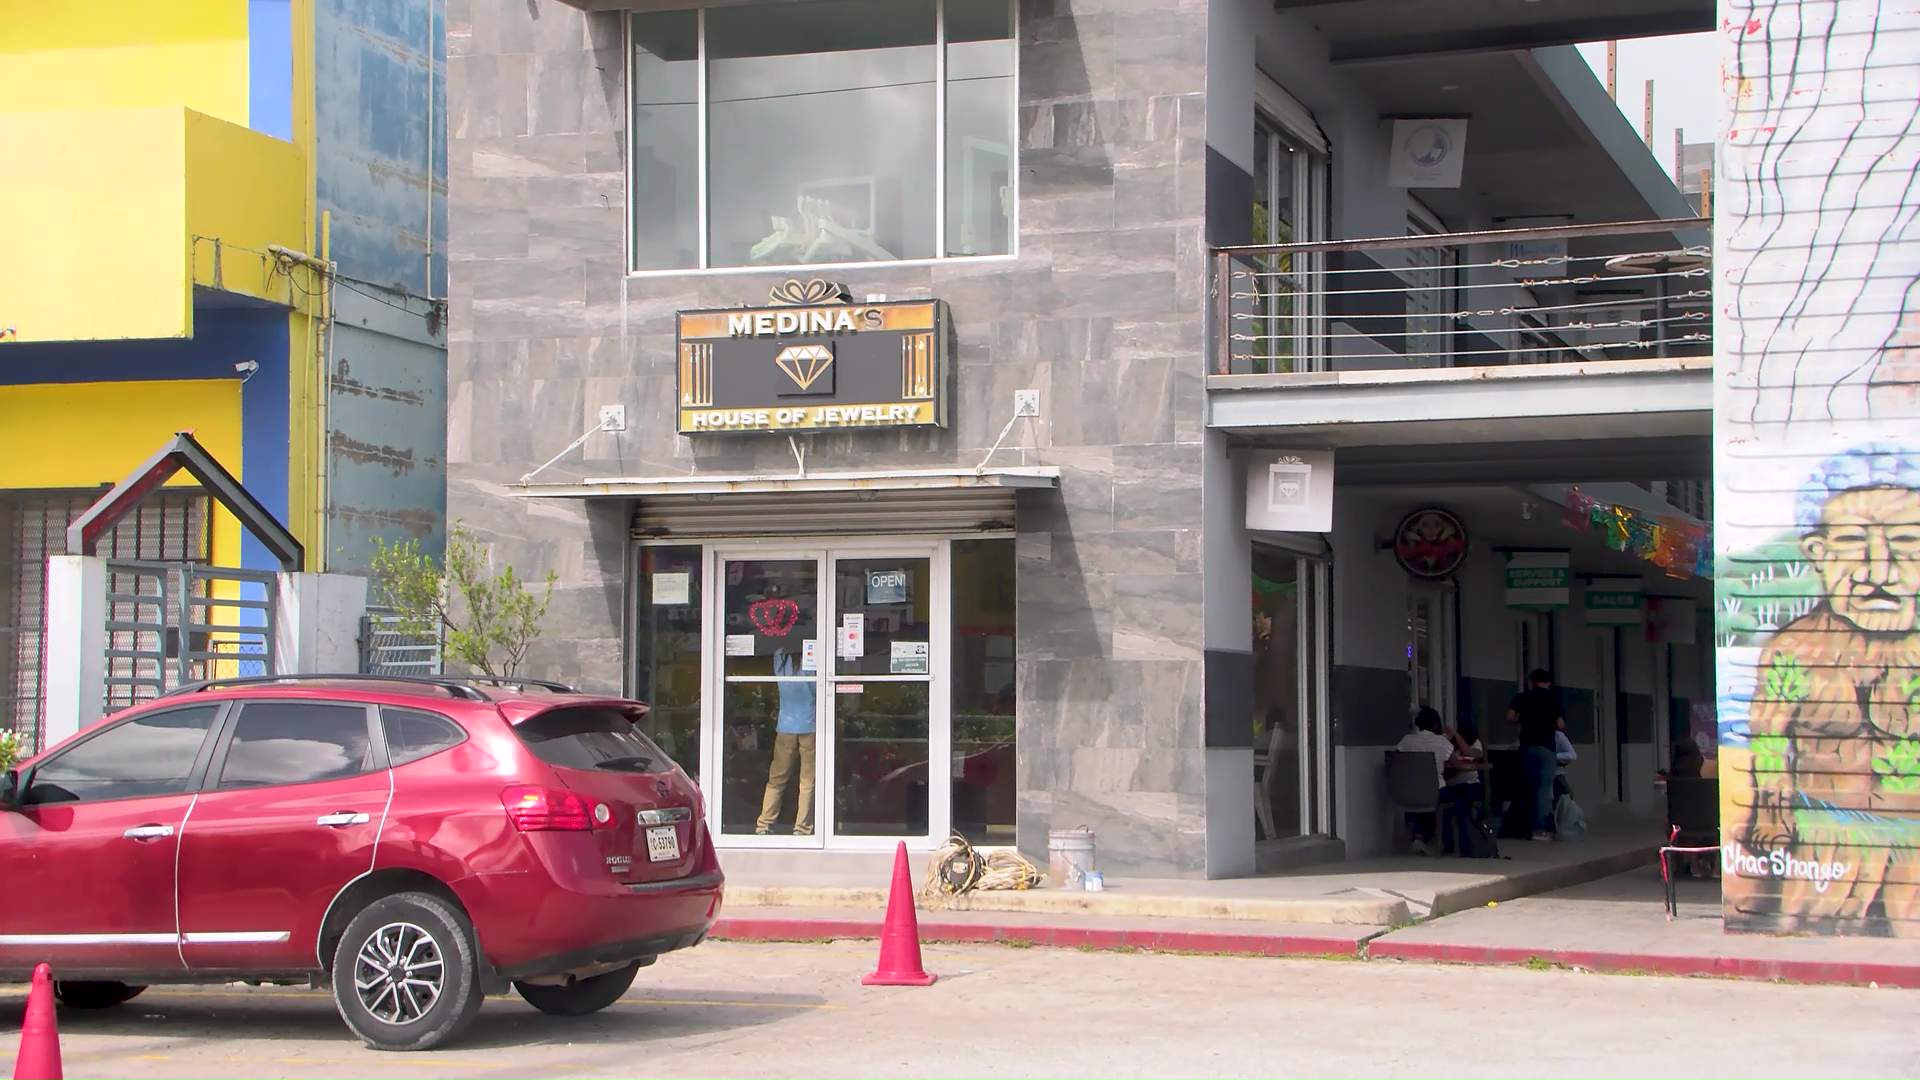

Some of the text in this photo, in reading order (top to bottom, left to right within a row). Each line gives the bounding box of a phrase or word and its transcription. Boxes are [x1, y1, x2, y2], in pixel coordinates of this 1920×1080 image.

[728, 309, 884, 336] MEDINA'S
[692, 404, 919, 427] HOUSE OF JEWELRY
[871, 575, 903, 588] OPEN
[1722, 841, 1852, 893] Chac Shango
